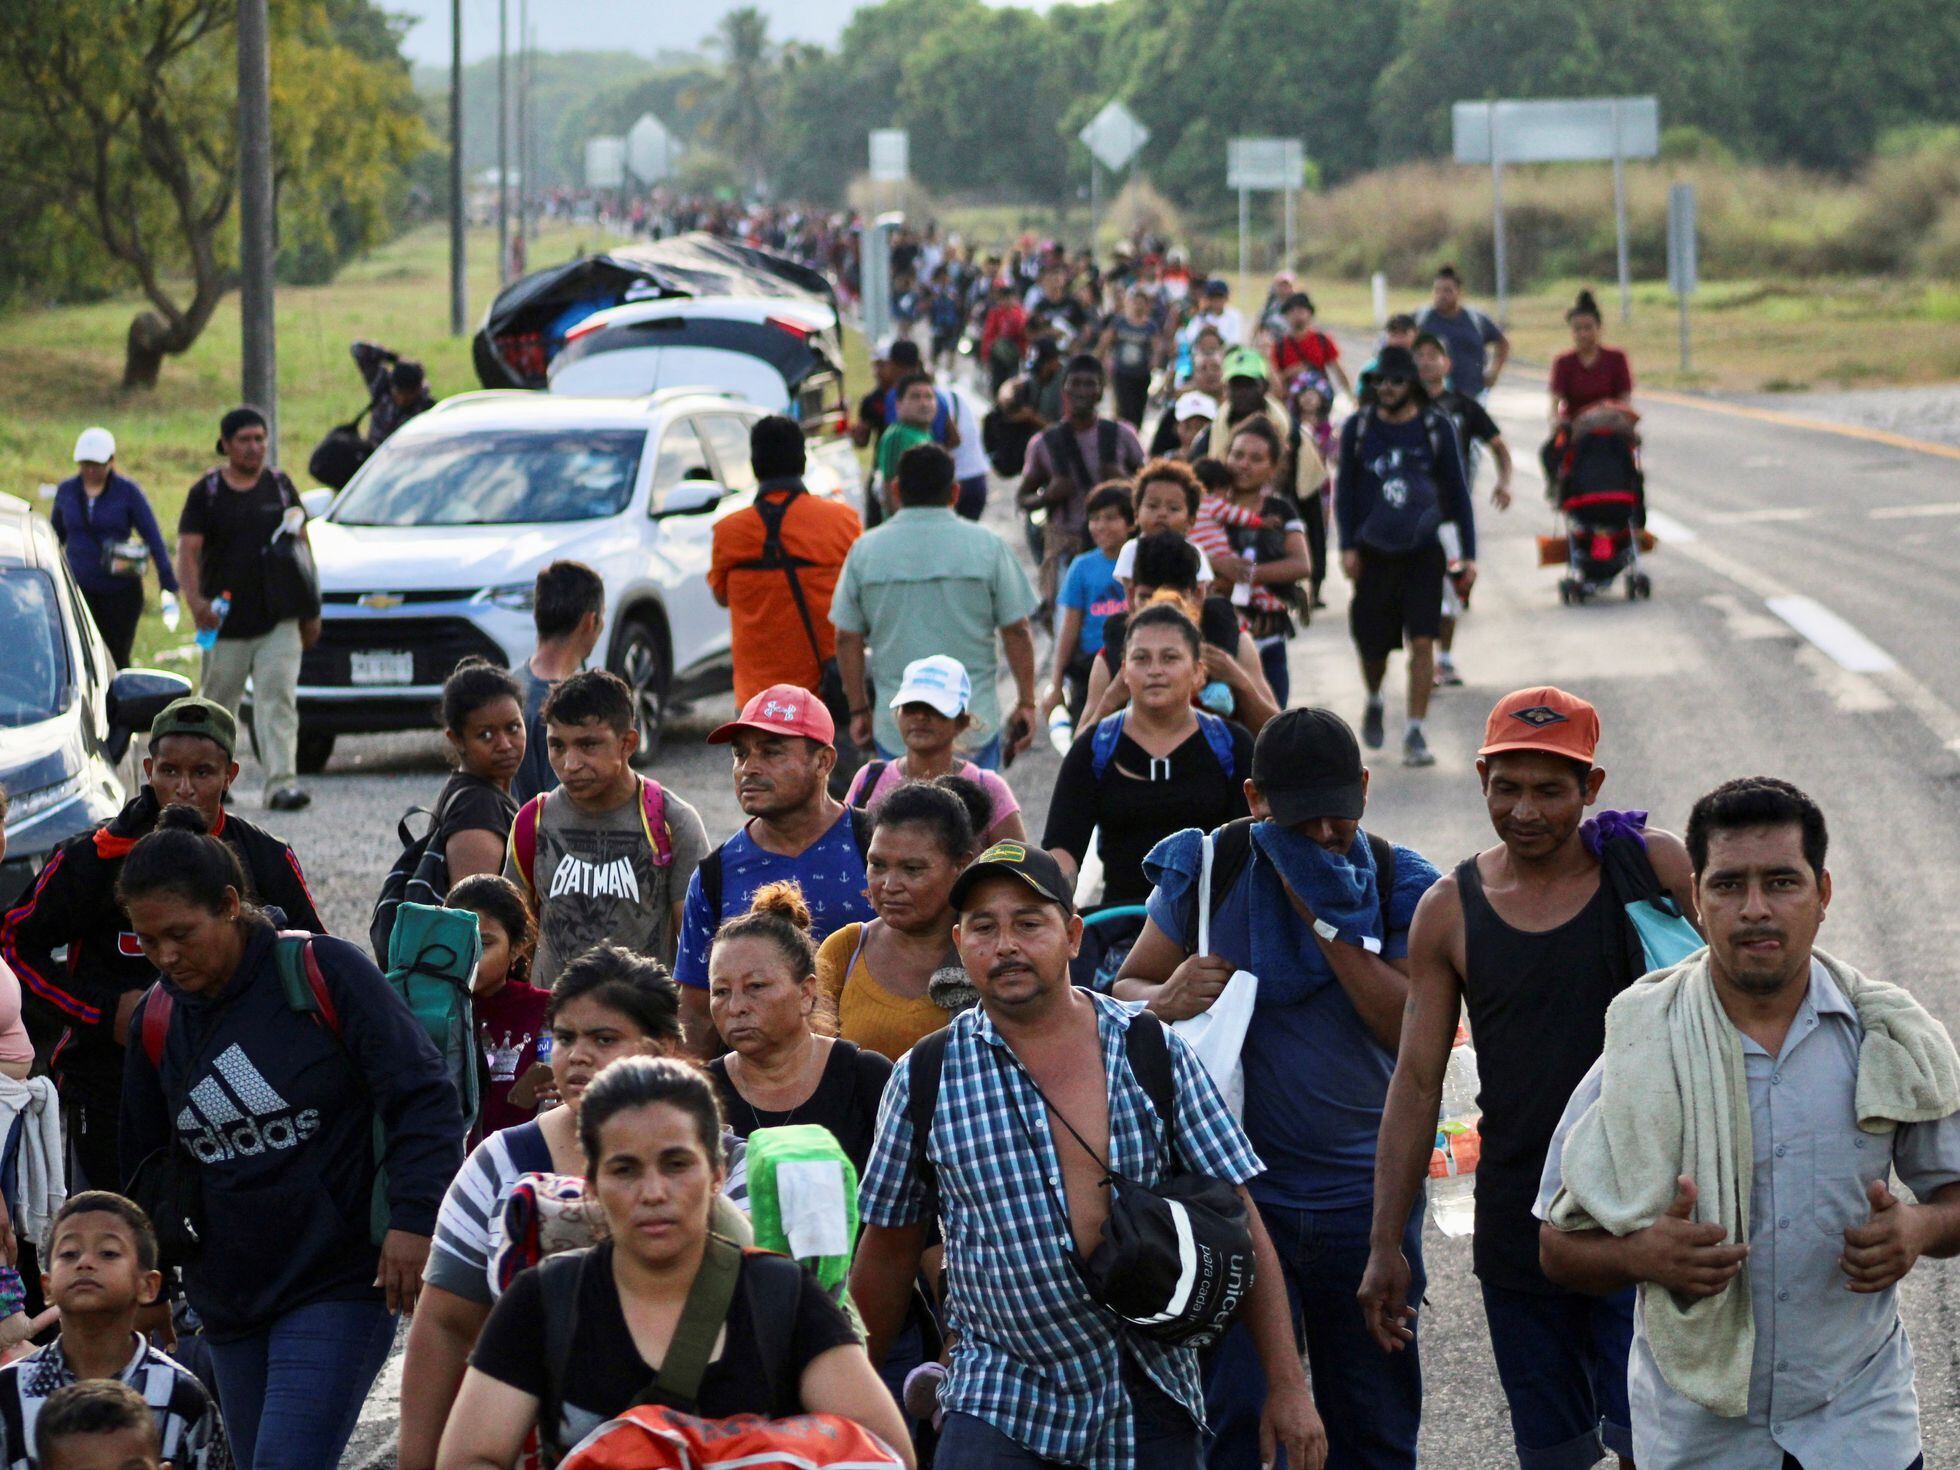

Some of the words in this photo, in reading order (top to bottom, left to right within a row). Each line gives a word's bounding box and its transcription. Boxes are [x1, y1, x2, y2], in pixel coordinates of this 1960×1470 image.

[549, 853, 640, 904] BATMAN
[180, 1108, 321, 1164] didas
[1198, 1243, 1213, 1278] para
[1192, 1280, 1211, 1312] cada
